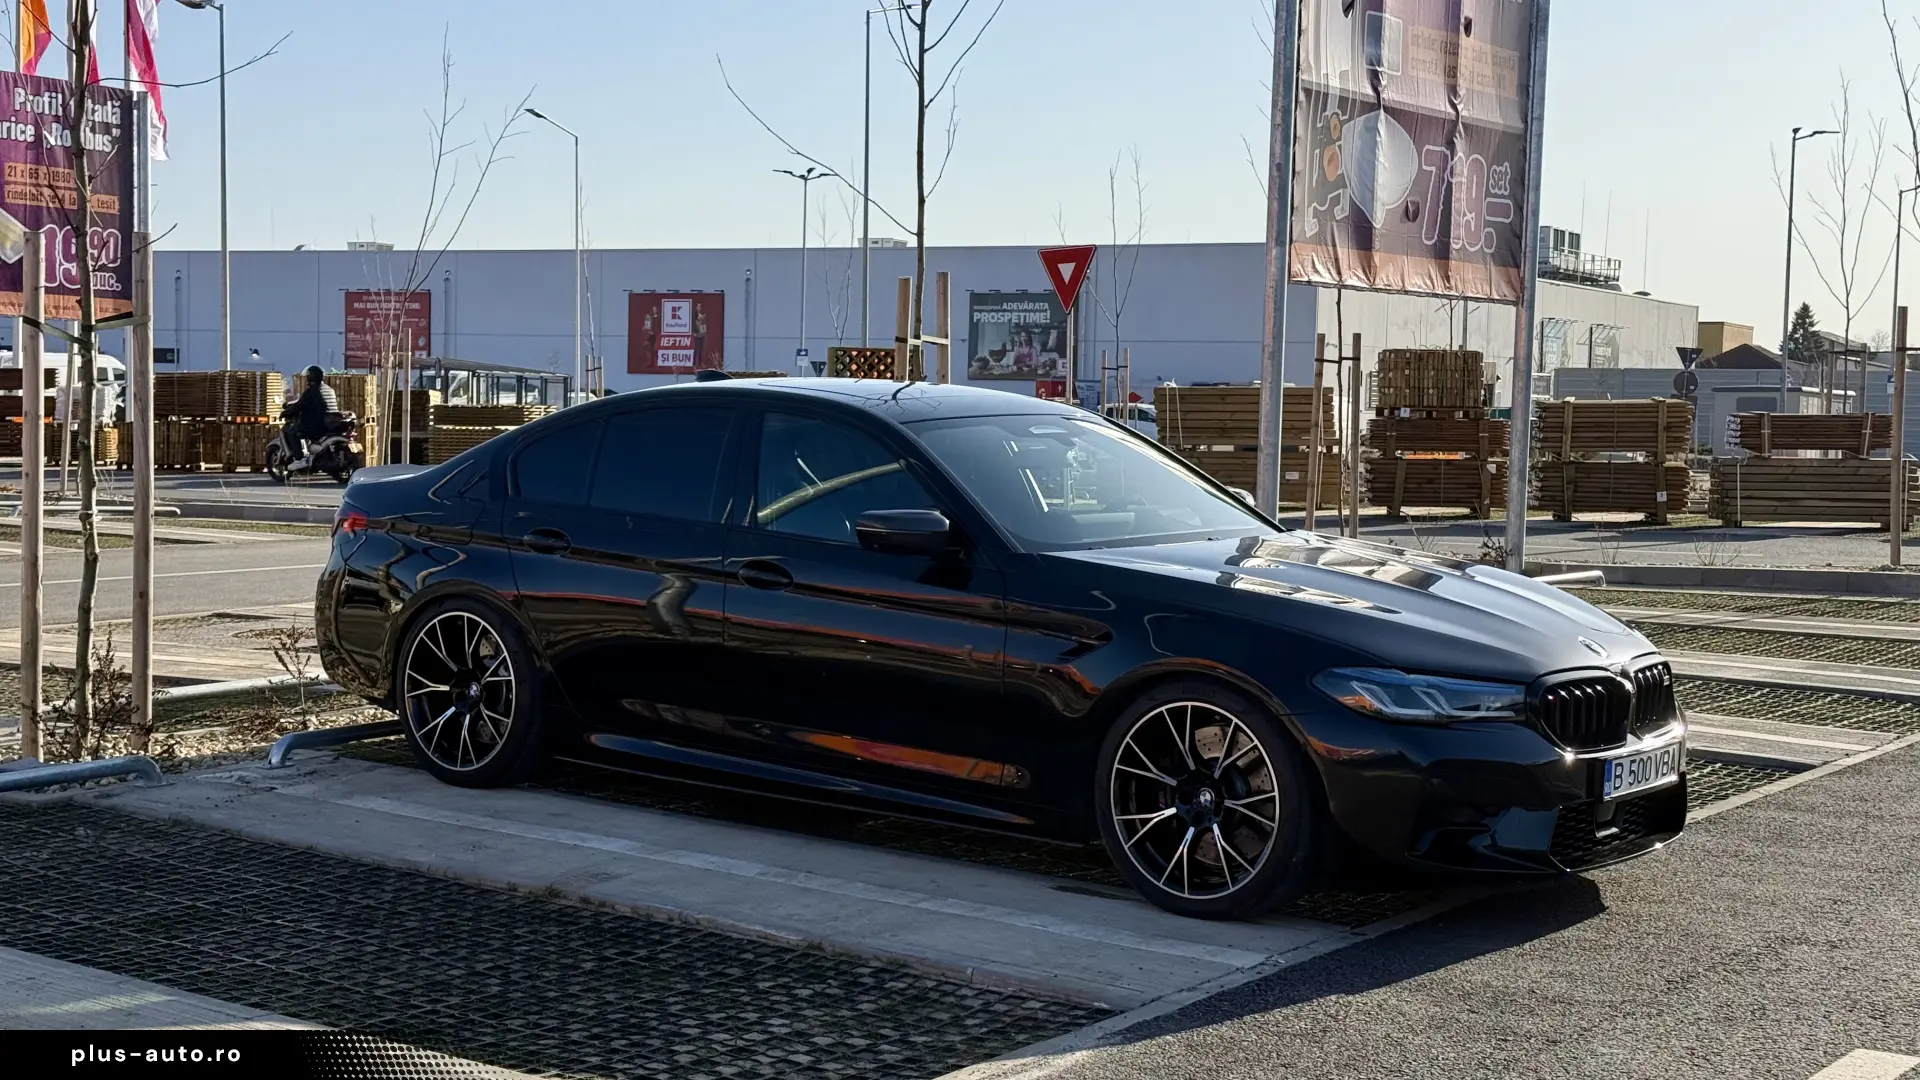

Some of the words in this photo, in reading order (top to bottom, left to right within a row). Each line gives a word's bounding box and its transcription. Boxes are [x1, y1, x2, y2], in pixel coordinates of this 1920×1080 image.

[14, 87, 63, 117] Profil
[0, 116, 35, 142] rice
[7, 165, 17, 178] 21
[20, 169, 25, 179] x
[28, 168, 39, 180] 65
[51, 170, 71, 184] 1980
[1488, 161, 1511, 195] set
[1002, 301, 1049, 310] ADEVĂRATA
[973, 310, 1050, 326] PROSPEȚIME!
[660, 337, 691, 347] IEFTIN
[671, 353, 692, 362] BUN
[1613, 762, 1625, 791] B
[1628, 755, 1653, 787] 500
[1655, 747, 1676, 779] VBA
